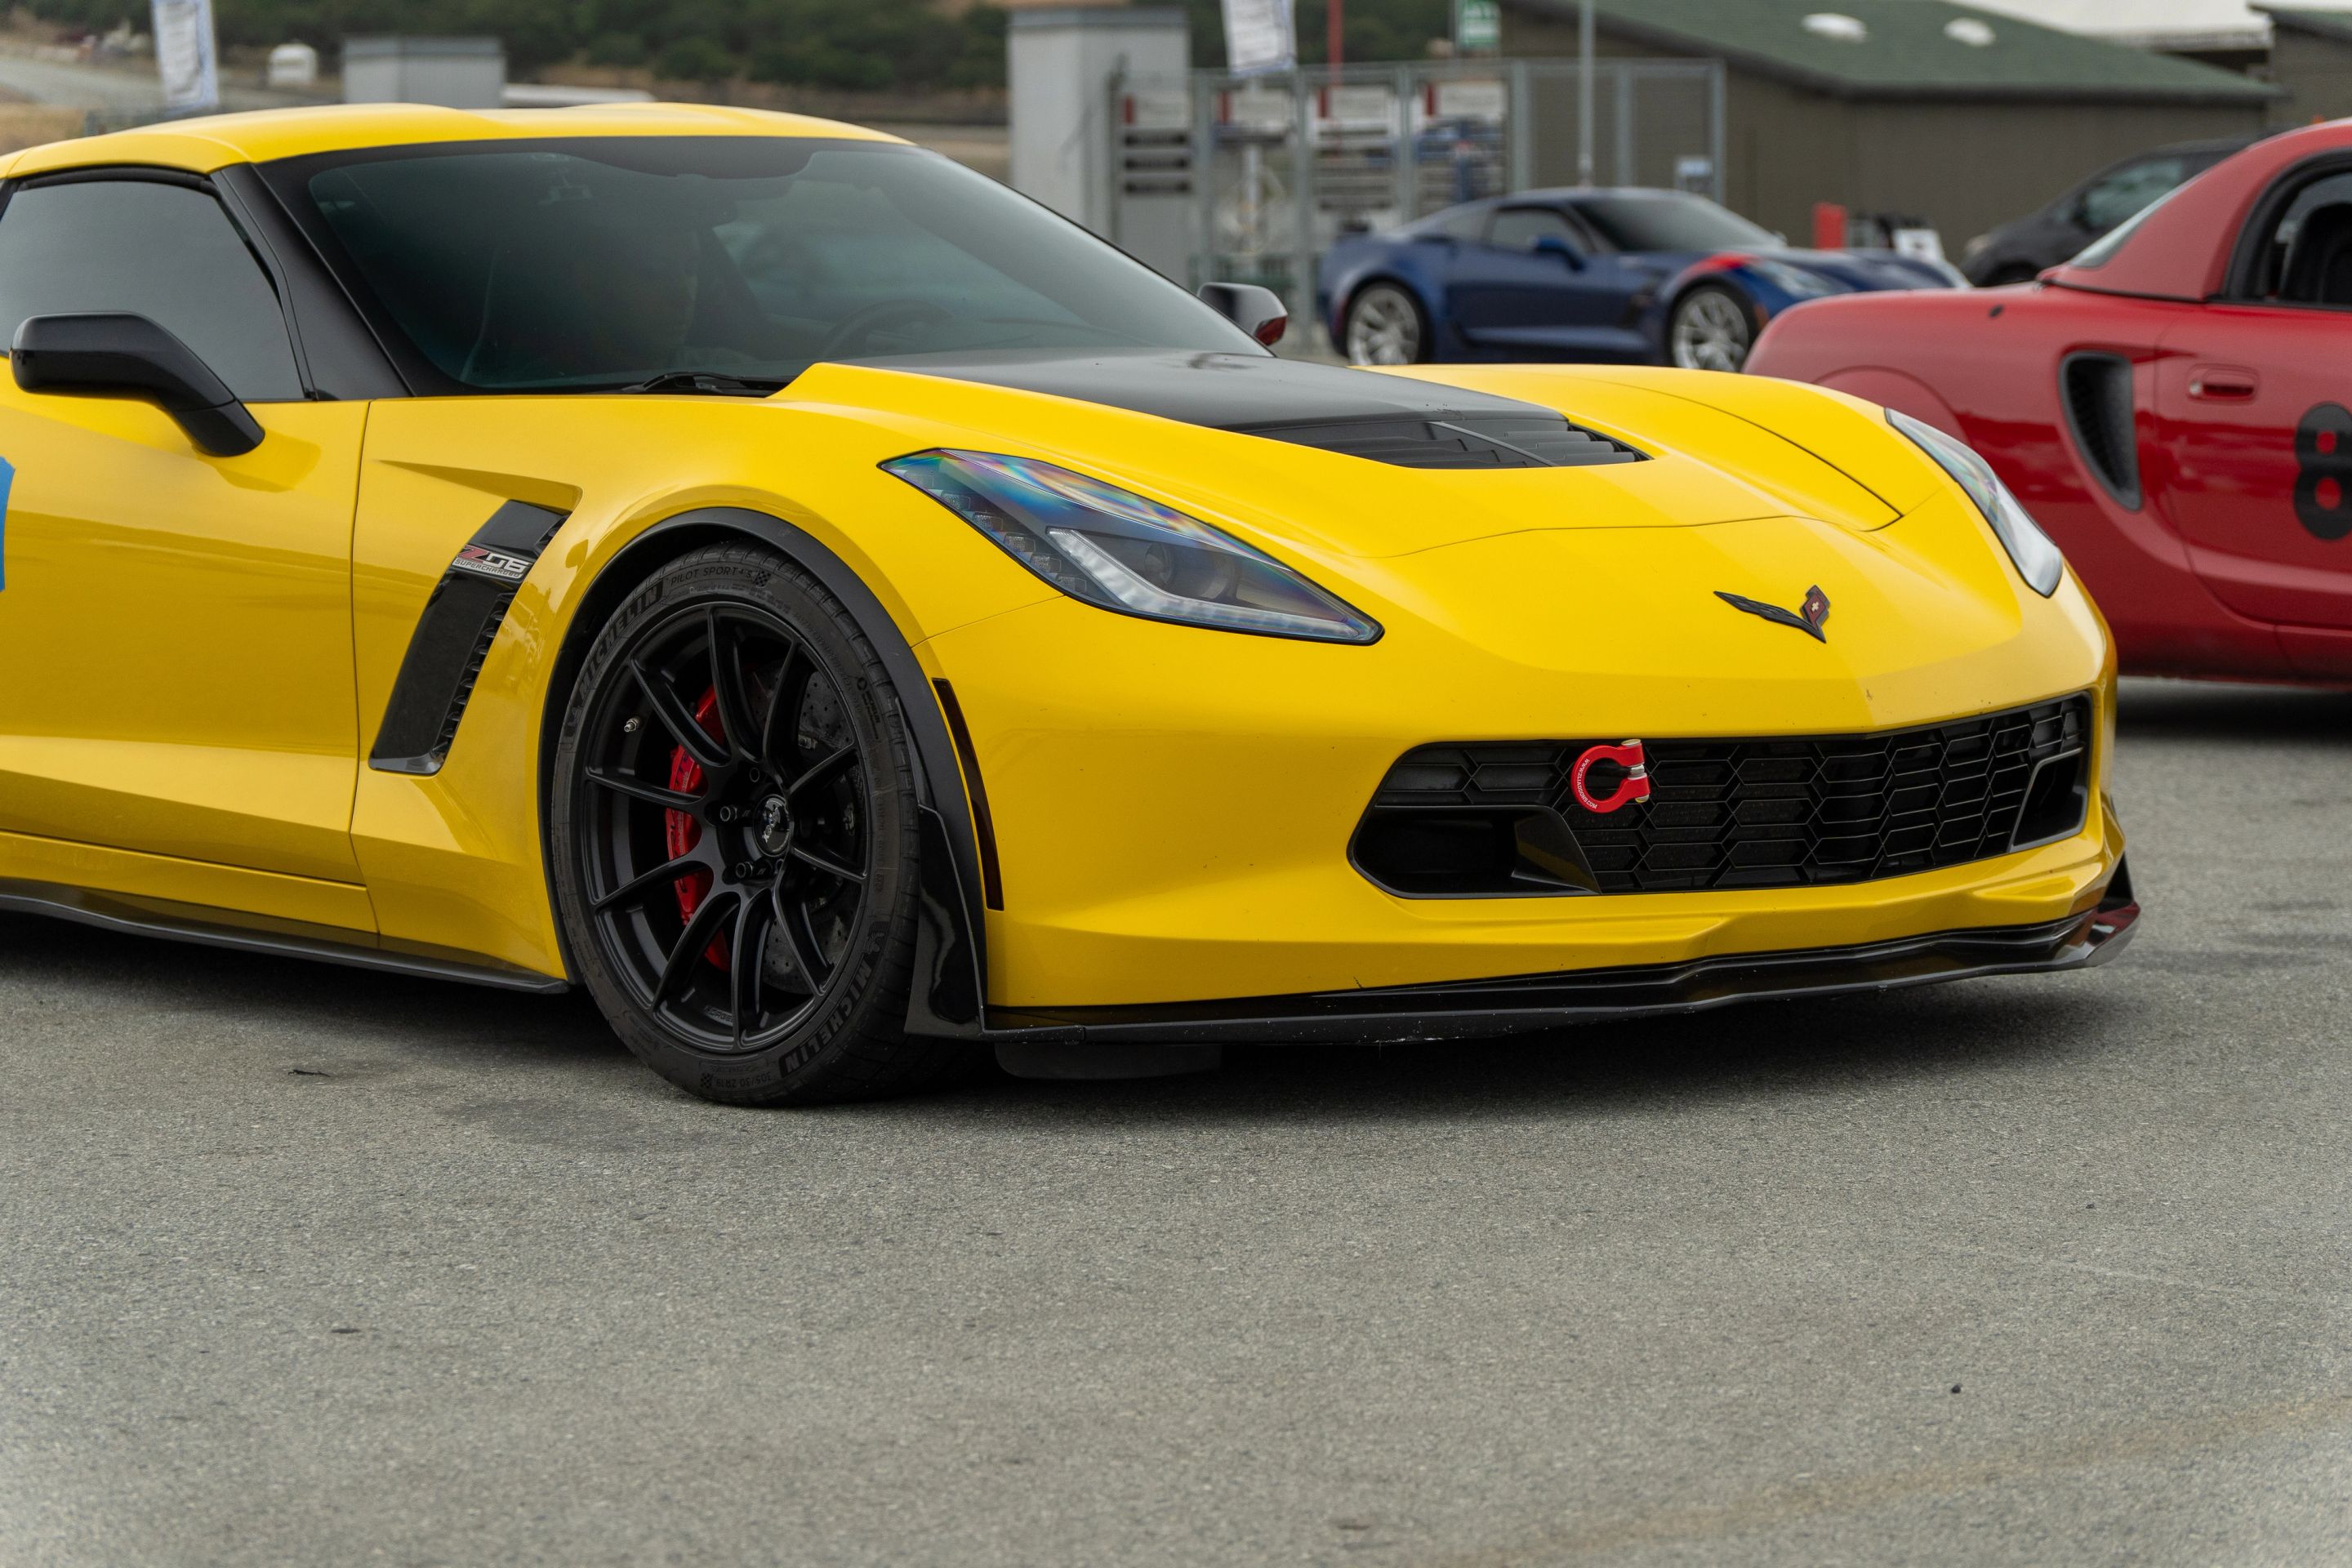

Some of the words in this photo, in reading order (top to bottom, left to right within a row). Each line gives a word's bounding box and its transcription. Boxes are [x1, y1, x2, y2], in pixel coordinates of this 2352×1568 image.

[2293, 400, 2352, 541] 8
[454, 558, 522, 577] SUPERCHARGED
[457, 544, 533, 573] Z06
[670, 568, 698, 586] PILOT
[703, 566, 737, 577] SPORT
[578, 583, 659, 700] MICHELIN
[784, 959, 872, 1073] MICHELIN
[739, 1071, 772, 1087] 305/30
